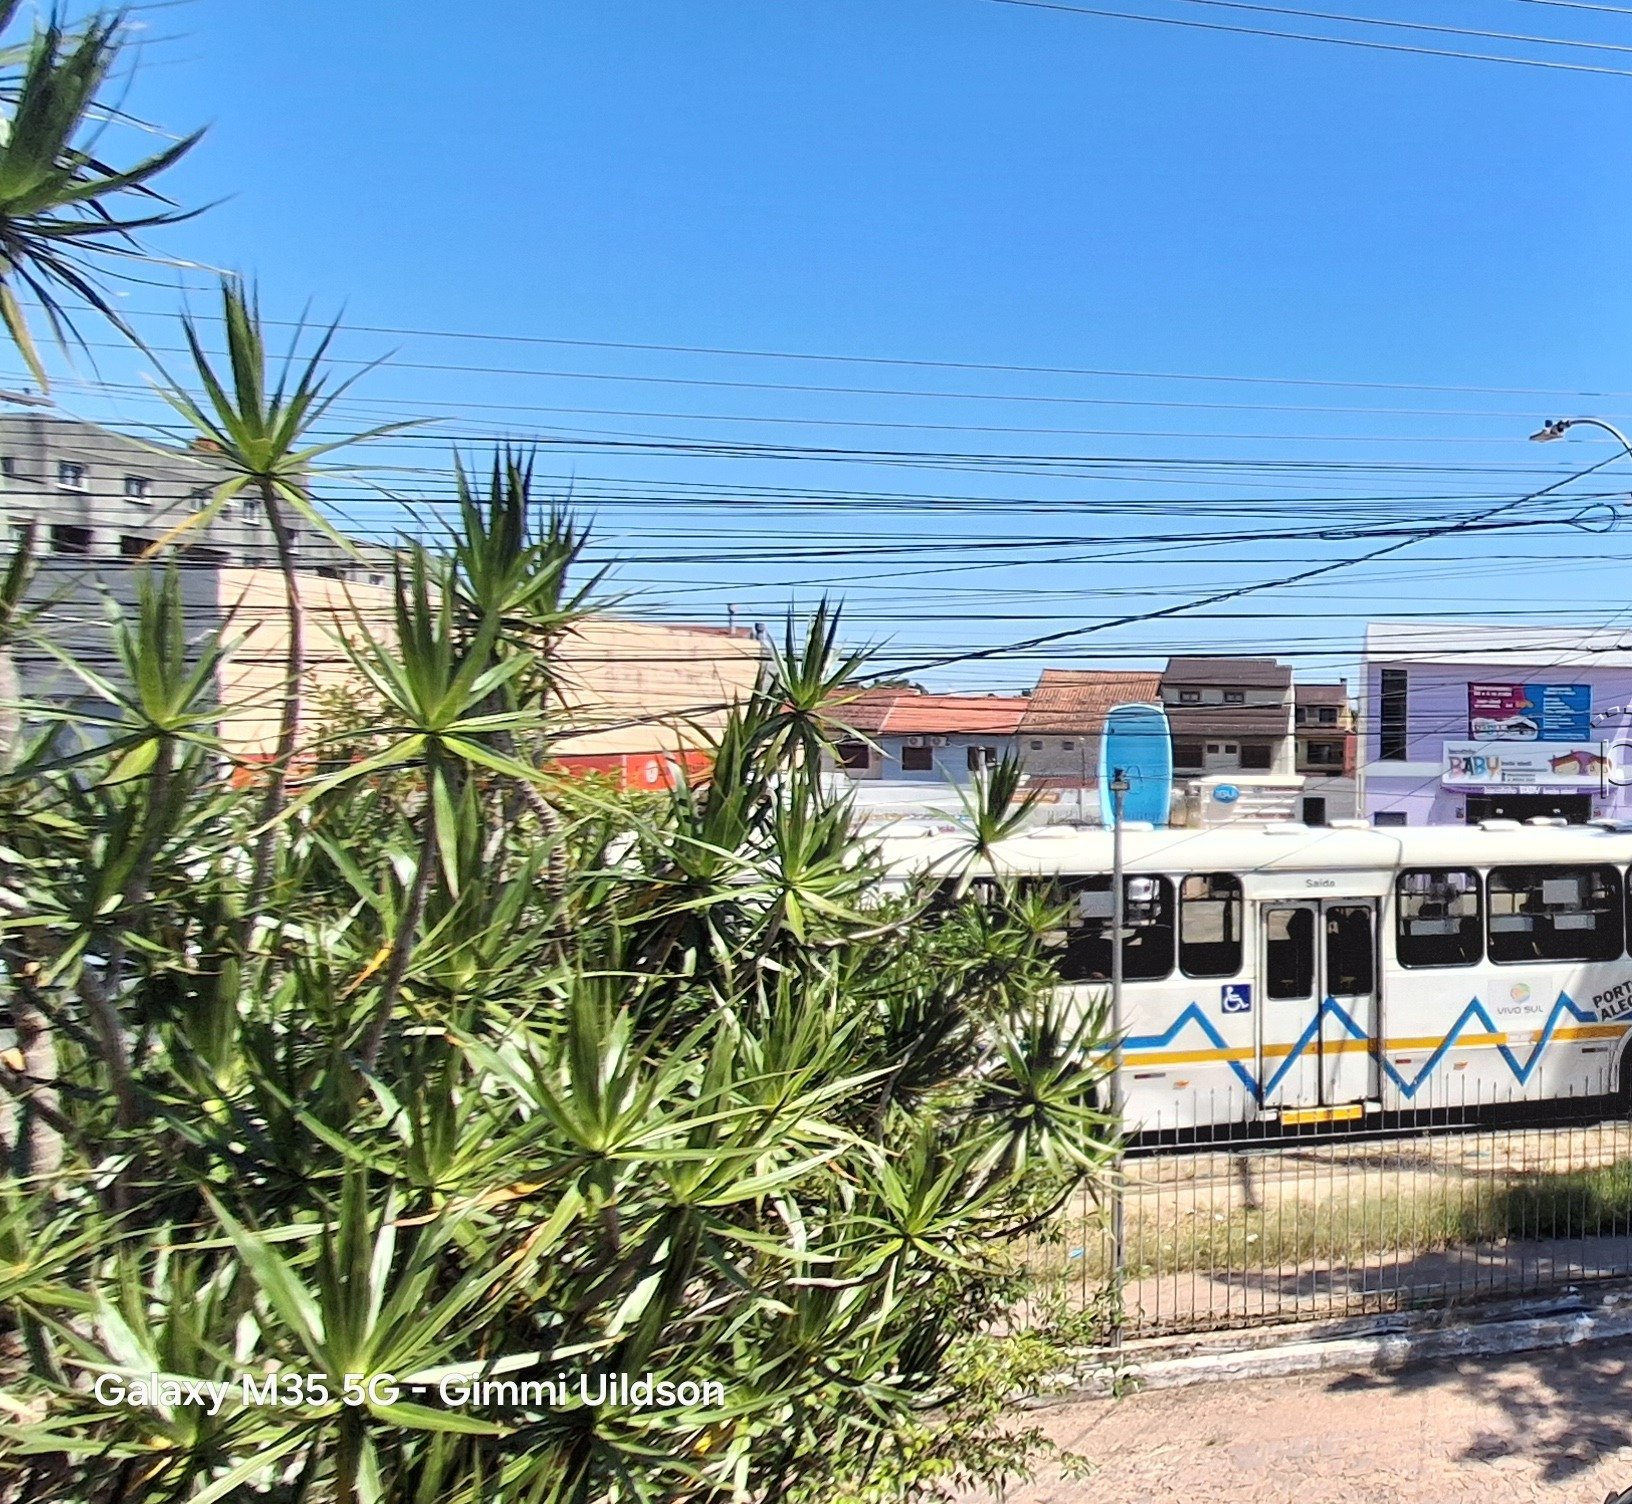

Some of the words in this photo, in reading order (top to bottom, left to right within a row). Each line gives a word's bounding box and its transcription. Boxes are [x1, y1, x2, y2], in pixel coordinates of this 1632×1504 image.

[1448, 756, 1500, 780] BABY
[1497, 1006, 1521, 1014] VIVO
[1524, 1005, 1544, 1013] SUL
